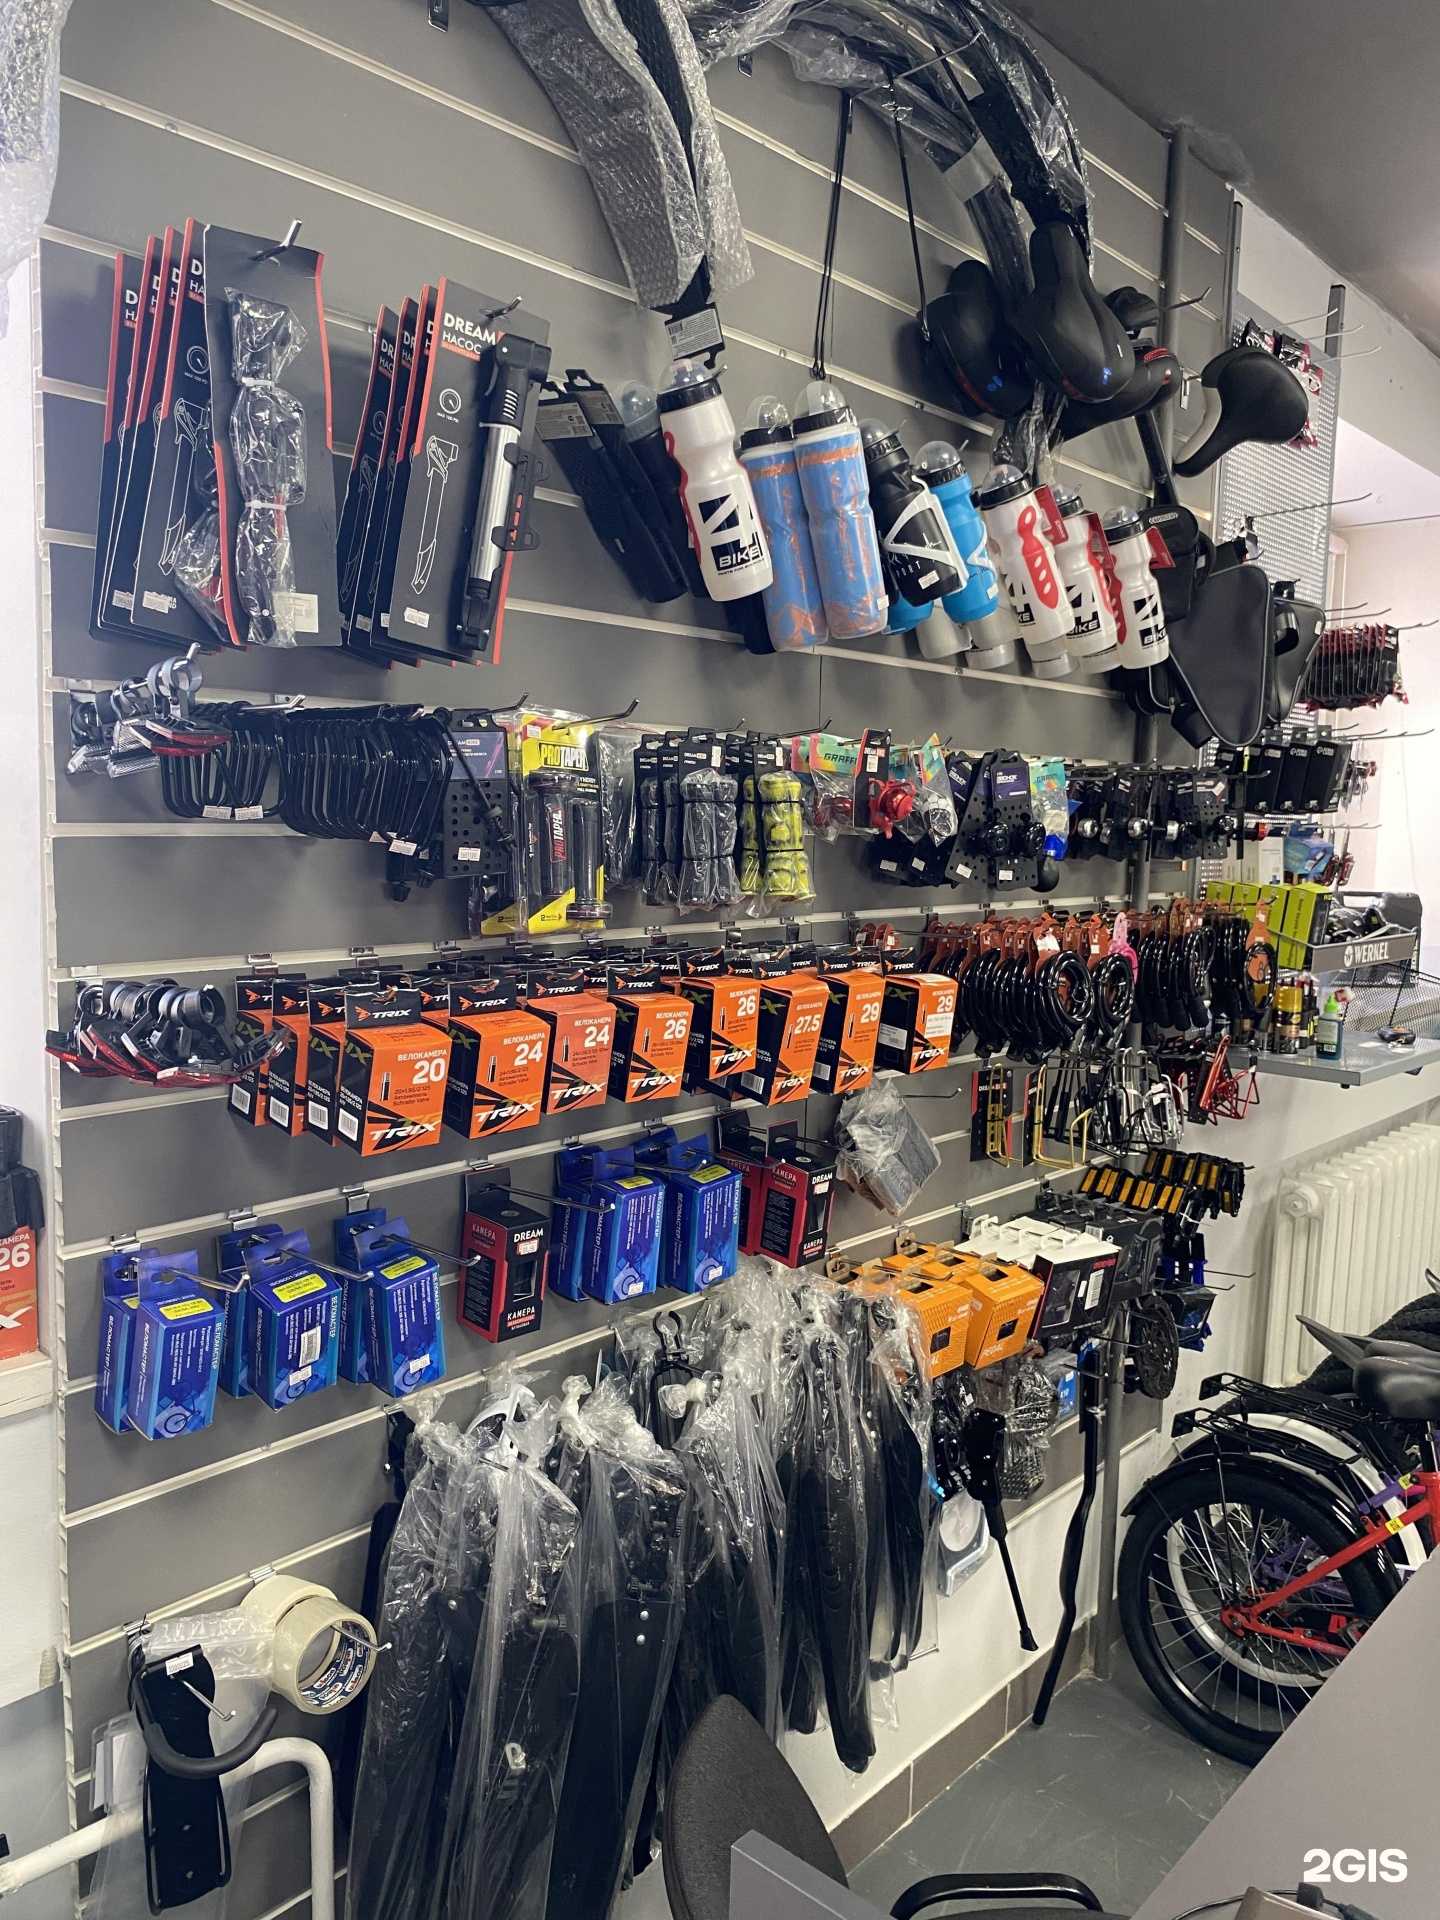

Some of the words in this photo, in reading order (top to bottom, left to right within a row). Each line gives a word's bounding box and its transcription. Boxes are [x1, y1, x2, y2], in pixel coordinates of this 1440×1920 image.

[443, 312, 496, 346] DREAM
[718, 546, 761, 568] BIKE
[552, 809, 568, 861] PROTAPER
[1354, 941, 1389, 964] WERKEL
[696, 962, 720, 972] TRIX
[894, 962, 915, 970] TRIX
[547, 984, 579, 994] TRIX
[626, 980, 655, 989] TRIX
[473, 997, 509, 1008] TRIX
[736, 995, 756, 1017] 26
[936, 995, 954, 1013] 29
[371, 1008, 412, 1019] TRIX
[860, 1001, 880, 1024] 29
[663, 1018, 688, 1040] 26
[794, 1013, 821, 1035] 27.5
[503, 1032, 545, 1046] ВЕЛОКАМЕРА
[584, 1024, 610, 1048] 24
[397, 1049, 448, 1062] ВЕЛОКАМЕРА
[513, 1040, 543, 1067] 24
[711, 1047, 756, 1066] TRIX
[912, 1046, 946, 1061] TRIX
[412, 1057, 446, 1085] 20
[631, 1072, 682, 1089] TRIX
[839, 1065, 870, 1079] TRIX
[551, 1081, 607, 1100] TRIX
[775, 1074, 810, 1090] TRIX
[474, 1099, 541, 1122] TRIX
[369, 1118, 442, 1141] TRIX
[811, 1172, 833, 1185] DREAM
[472, 1222, 496, 1241] КАМЕРА
[513, 1227, 544, 1243] DREAM
[0, 1242, 31, 1272] 26
[507, 1305, 536, 1321] КАМЕРА
[104, 1315, 114, 1367] ВЕЛОМАСТЕР
